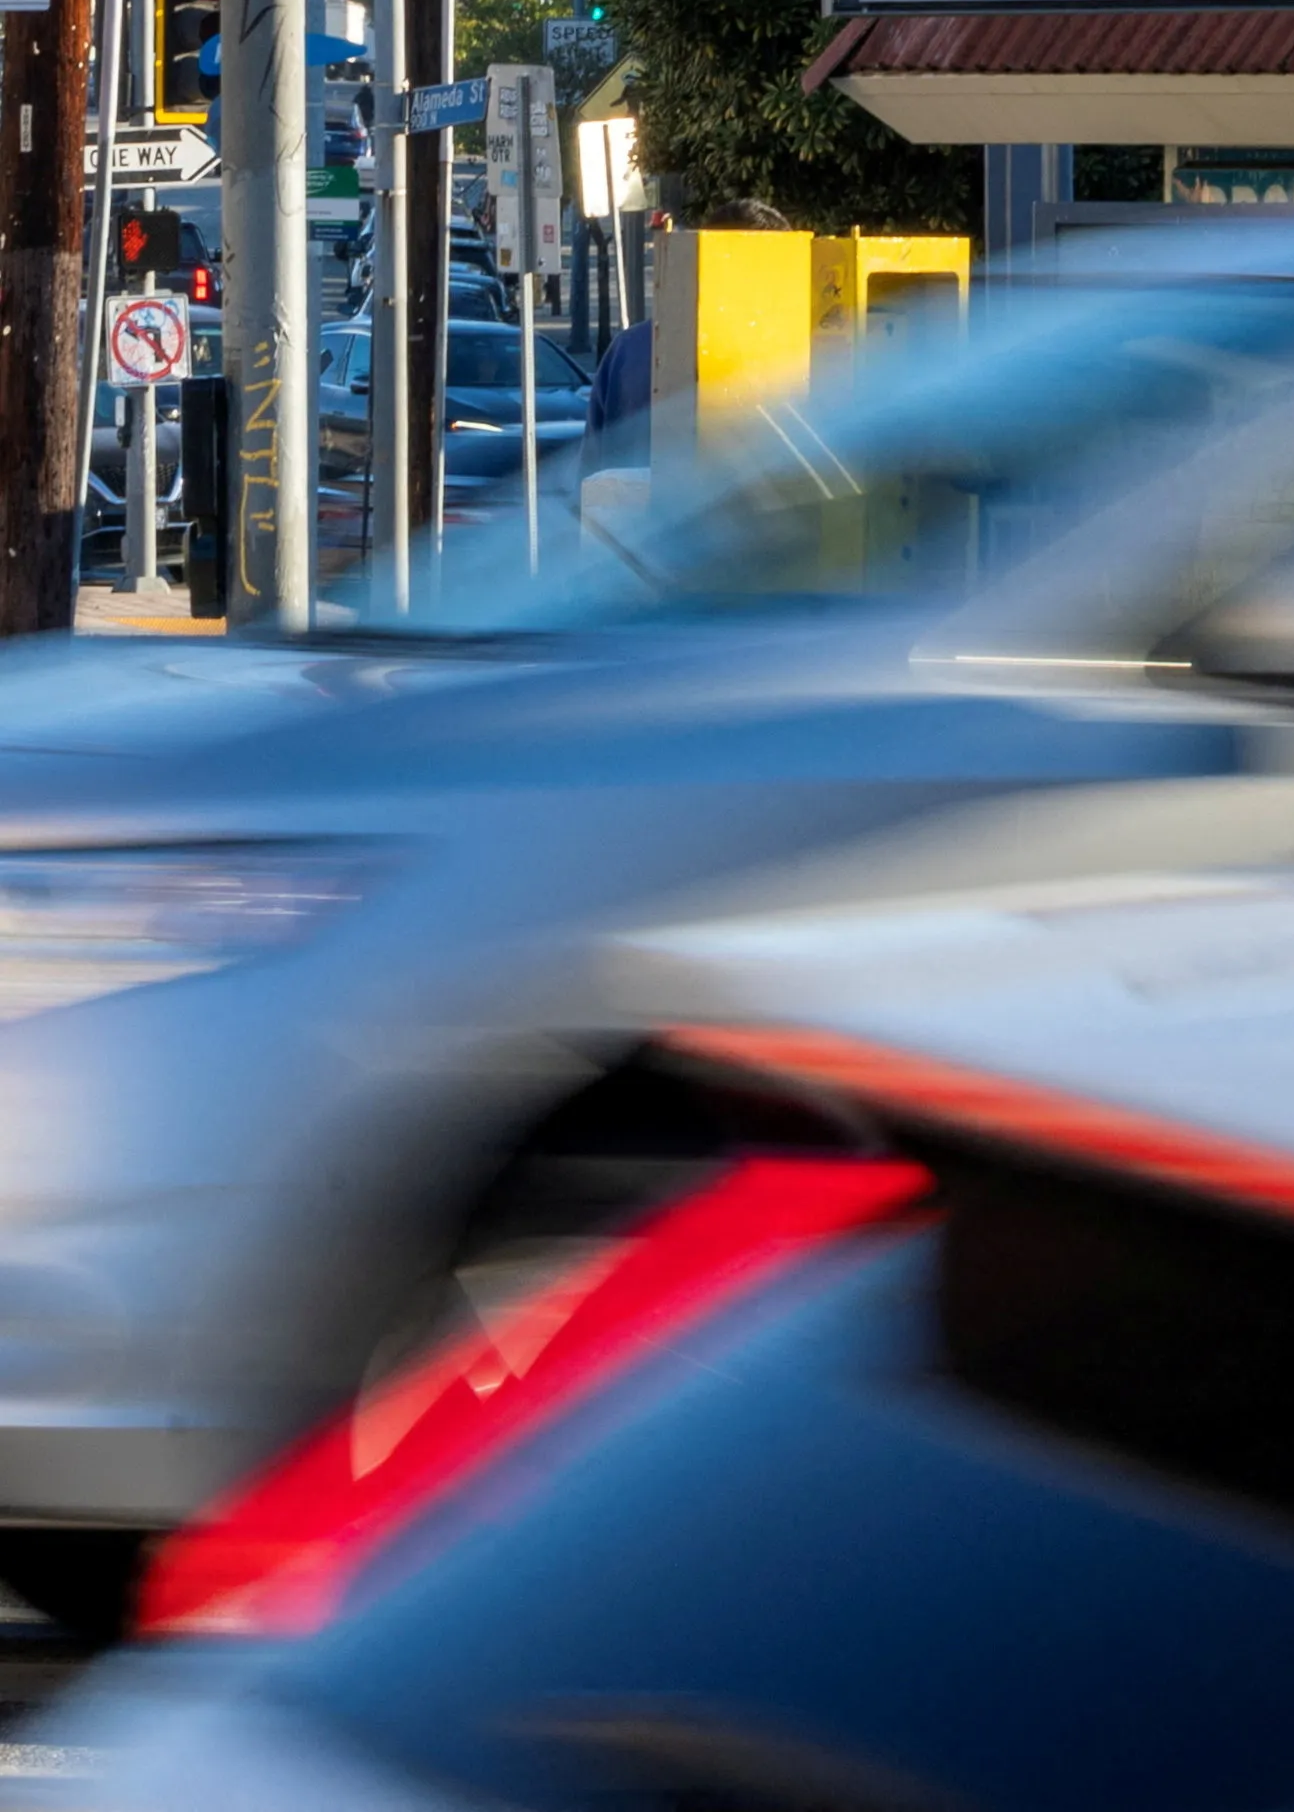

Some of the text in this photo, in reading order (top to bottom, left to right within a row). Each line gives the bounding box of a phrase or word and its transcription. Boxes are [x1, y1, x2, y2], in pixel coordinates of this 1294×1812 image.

[411, 86, 464, 114] Alameda
[469, 80, 485, 105] St
[89, 145, 178, 168] OE WAY
